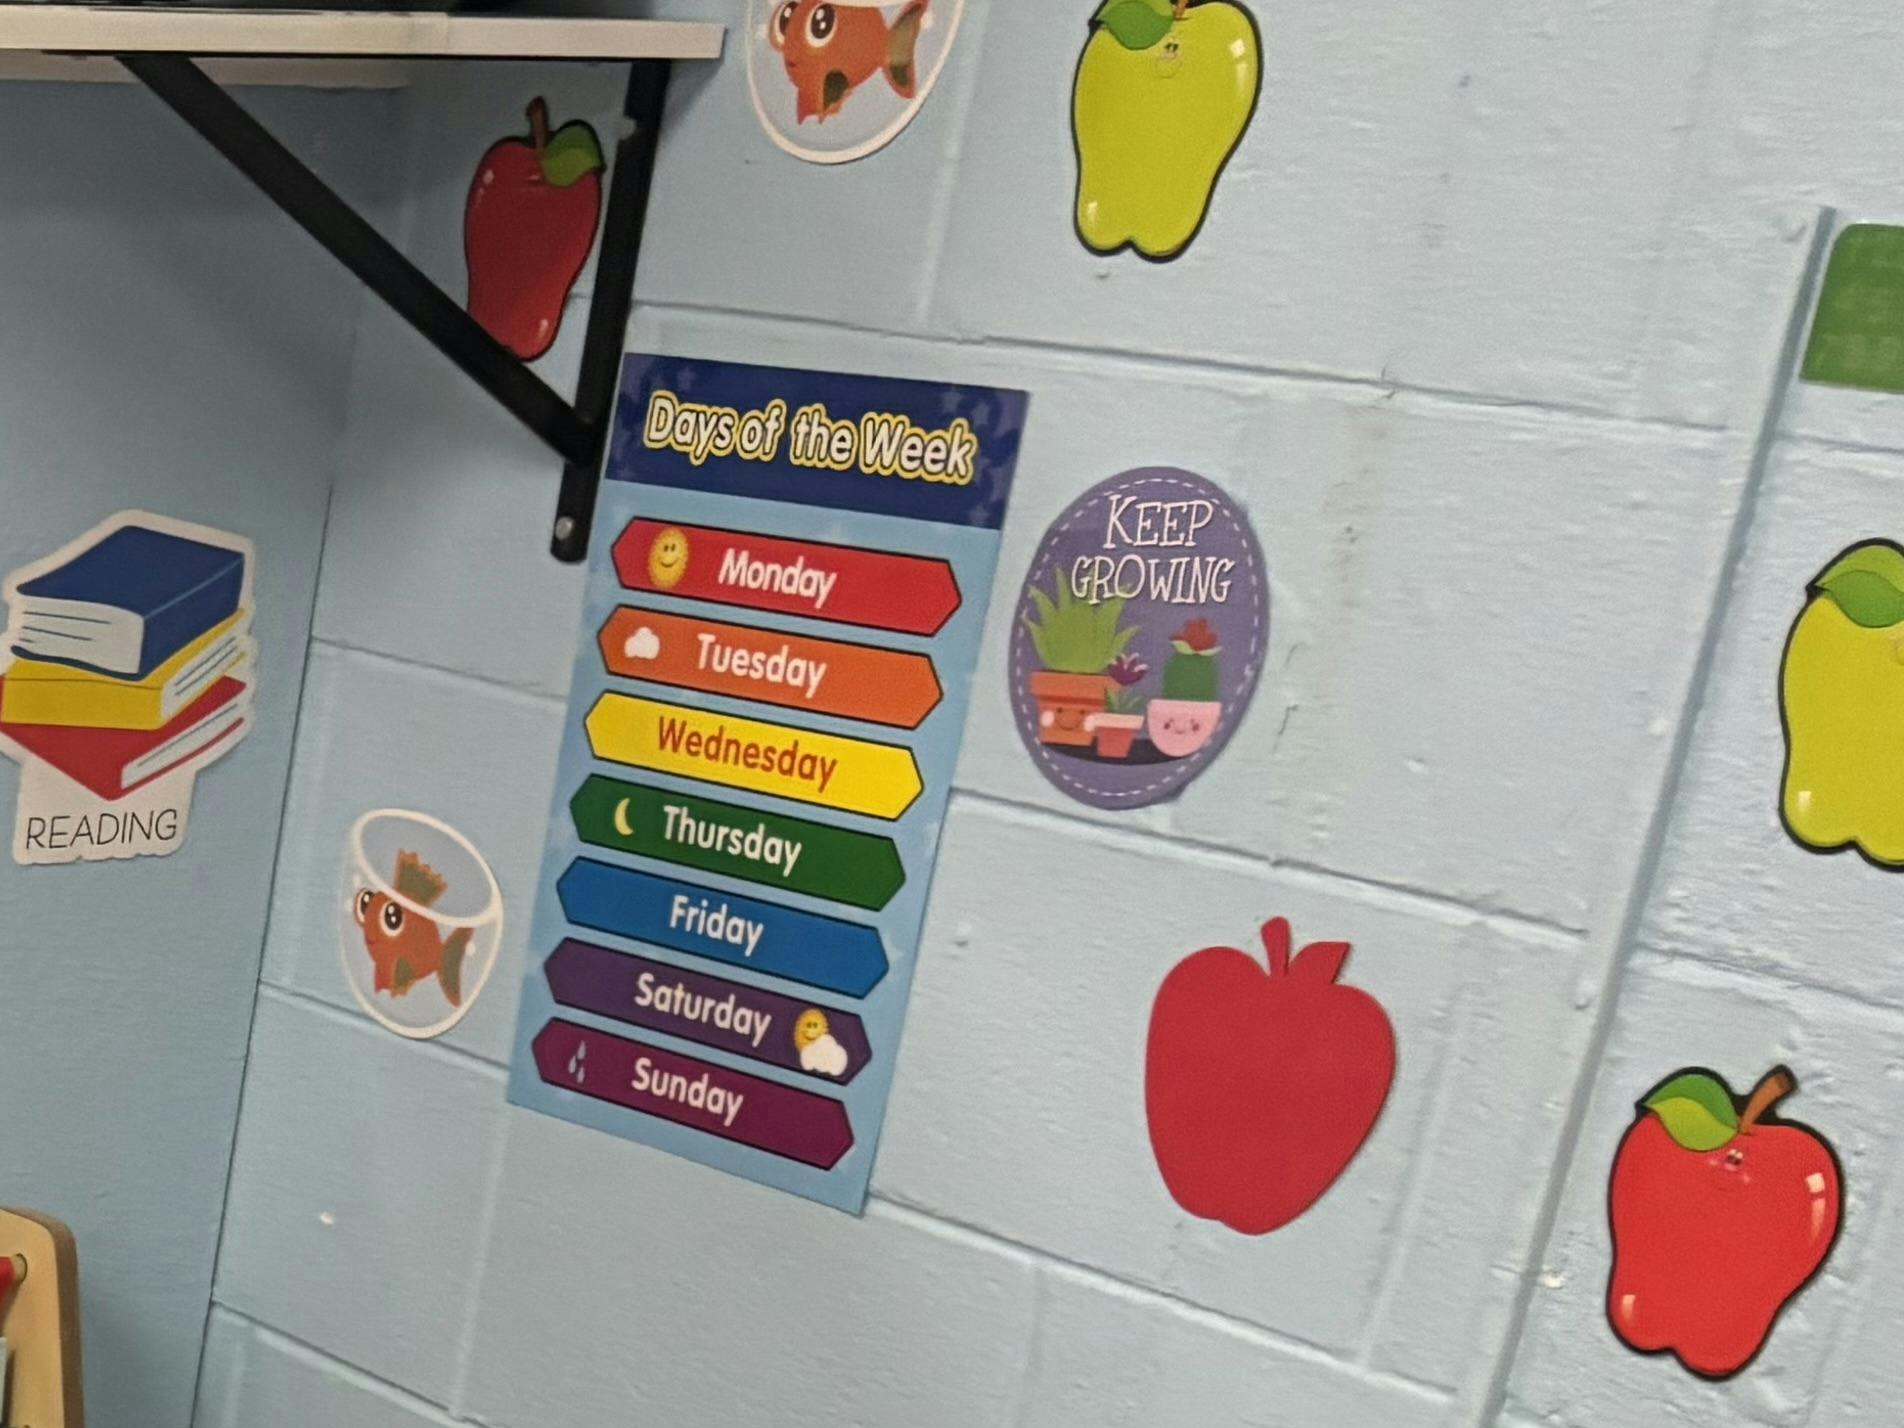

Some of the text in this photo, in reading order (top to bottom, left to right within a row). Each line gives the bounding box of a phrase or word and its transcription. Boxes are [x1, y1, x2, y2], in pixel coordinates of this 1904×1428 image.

[645, 392, 977, 485] Days of the Week
[1101, 492, 1216, 550] KEEP
[718, 548, 837, 603] Monday
[1071, 552, 1235, 607] GROWING
[696, 634, 827, 690] Tuesday
[657, 715, 838, 784] Wednesday
[23, 808, 180, 852] READING
[663, 805, 802, 871] Thursday
[669, 895, 764, 954] Friday
[635, 972, 772, 1047] Saturday
[631, 1057, 744, 1126] Sunday
